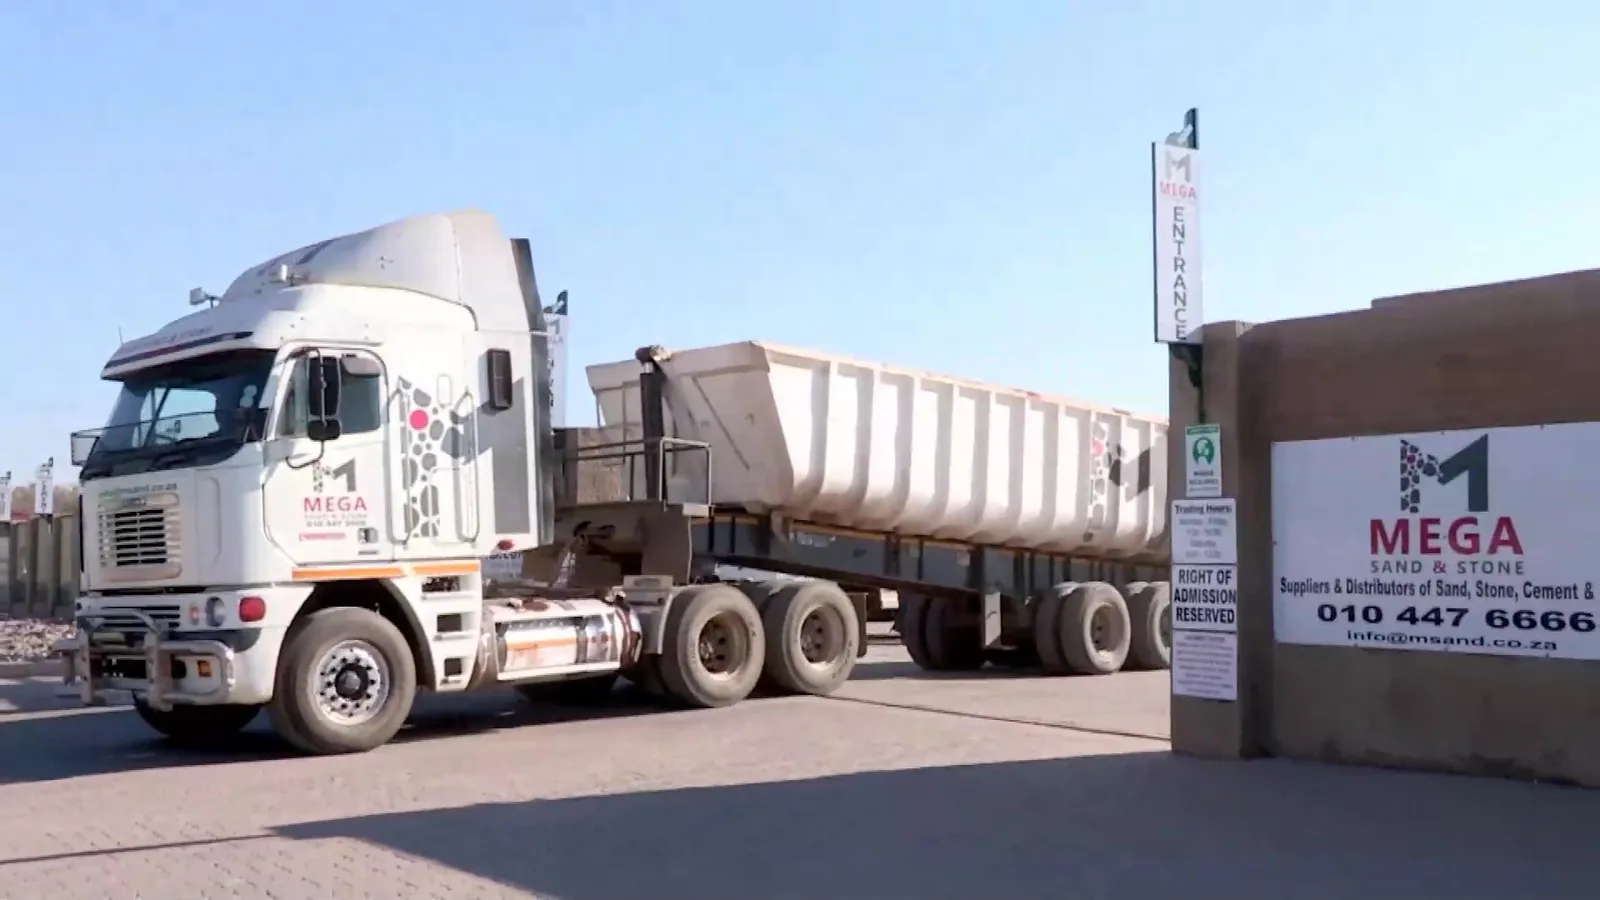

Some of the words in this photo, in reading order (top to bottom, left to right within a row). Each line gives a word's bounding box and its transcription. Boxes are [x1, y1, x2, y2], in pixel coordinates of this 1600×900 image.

[1160, 181, 1197, 199] MEGA
[1173, 206, 1187, 341] ENTRANCE
[303, 496, 368, 512] MEGA
[1370, 516, 1524, 555] MEGA
[1370, 560, 1422, 574] SAND
[1432, 560, 1446, 574] &
[1457, 560, 1525, 575] STONE
[1179, 569, 1213, 584] RIGHT
[1216, 569, 1232, 585] OF
[1174, 587, 1237, 605] ADMISSION
[1280, 577, 1330, 597] Suppliers
[1334, 578, 1342, 593] &
[1346, 578, 1416, 597] Distributors
[1419, 580, 1432, 597] of
[1436, 581, 1471, 600] Sand,
[1475, 581, 1518, 602] Stone,
[1523, 582, 1578, 600] Cement
[1584, 584, 1594, 600] &
[1176, 606, 1235, 624] RESERVED
[1317, 603, 1383, 625] 010
[1396, 605, 1469, 627] 447
[1485, 609, 1596, 632] 6666
[1347, 630, 1558, 651] info@msand.co.za
